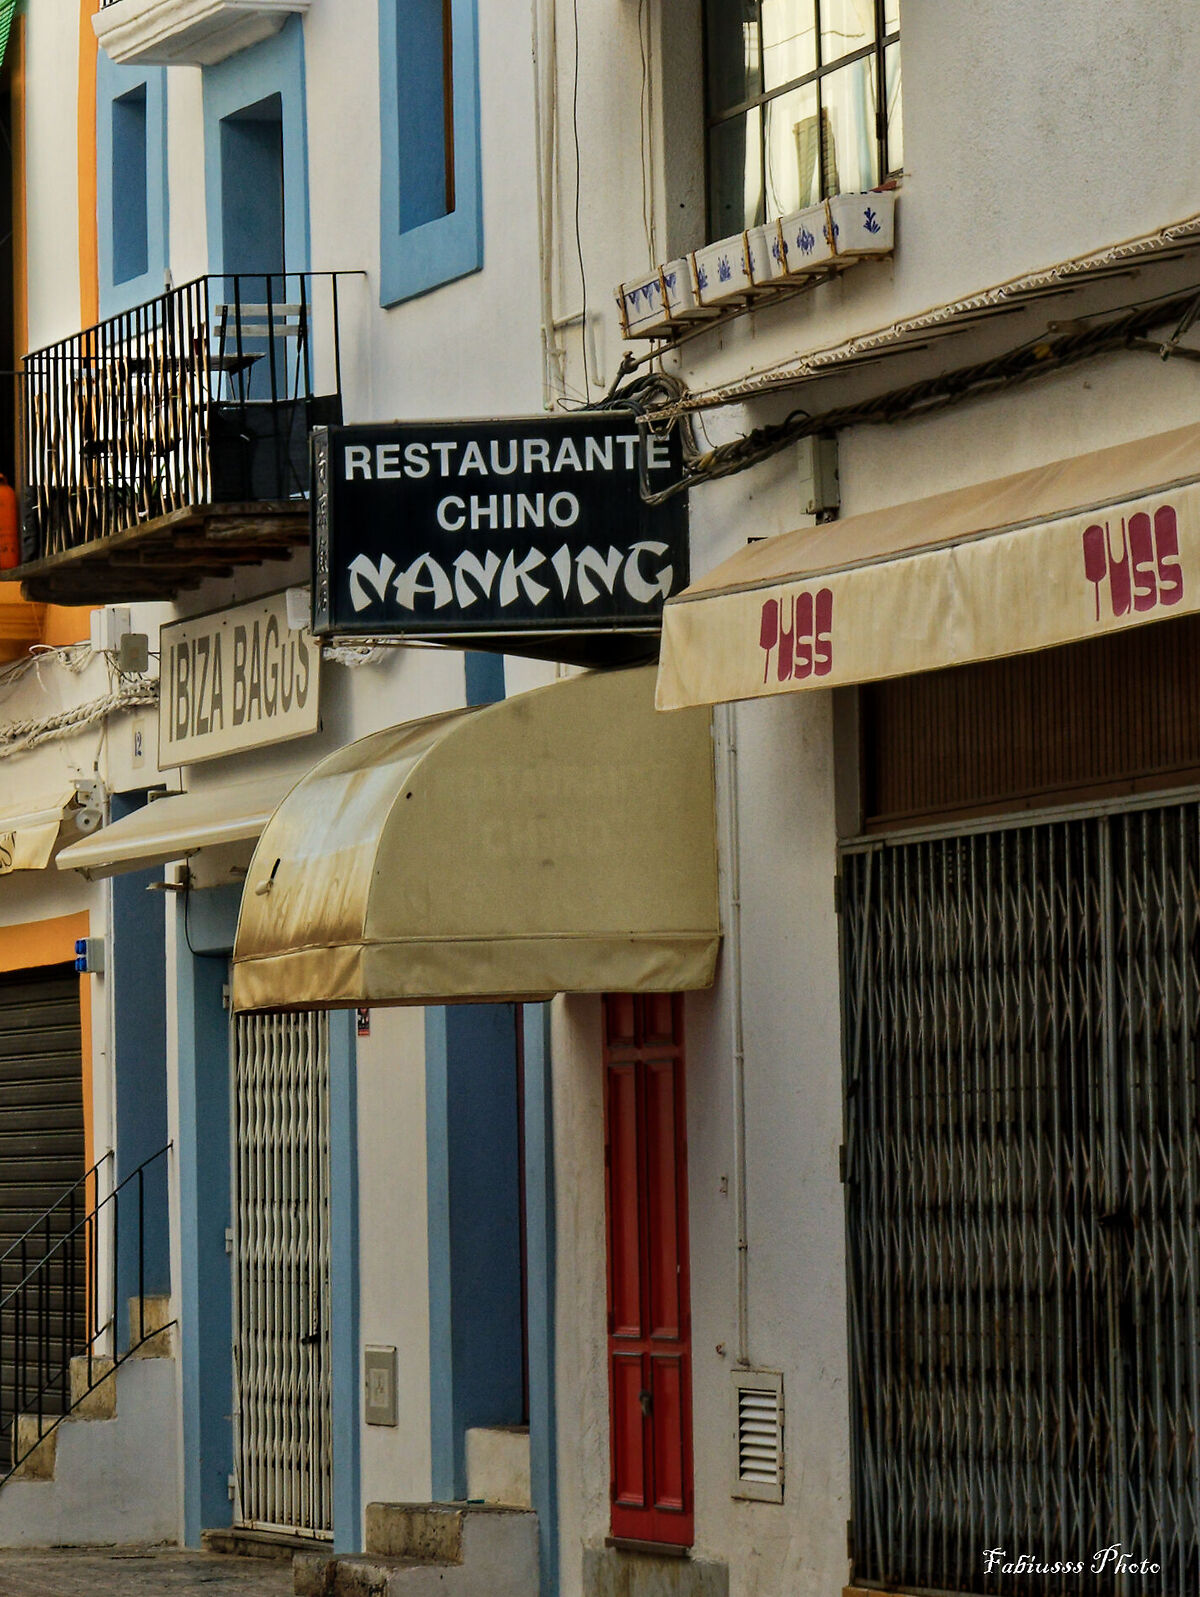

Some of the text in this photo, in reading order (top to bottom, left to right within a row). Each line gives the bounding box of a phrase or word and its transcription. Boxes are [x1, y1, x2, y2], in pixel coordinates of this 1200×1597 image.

[343, 433, 672, 481] RESTAURANTE
[435, 490, 581, 532] CHINO
[347, 540, 674, 613] NANKING
[169, 631, 224, 743] IBIZA
[133, 731, 142, 757] 12
